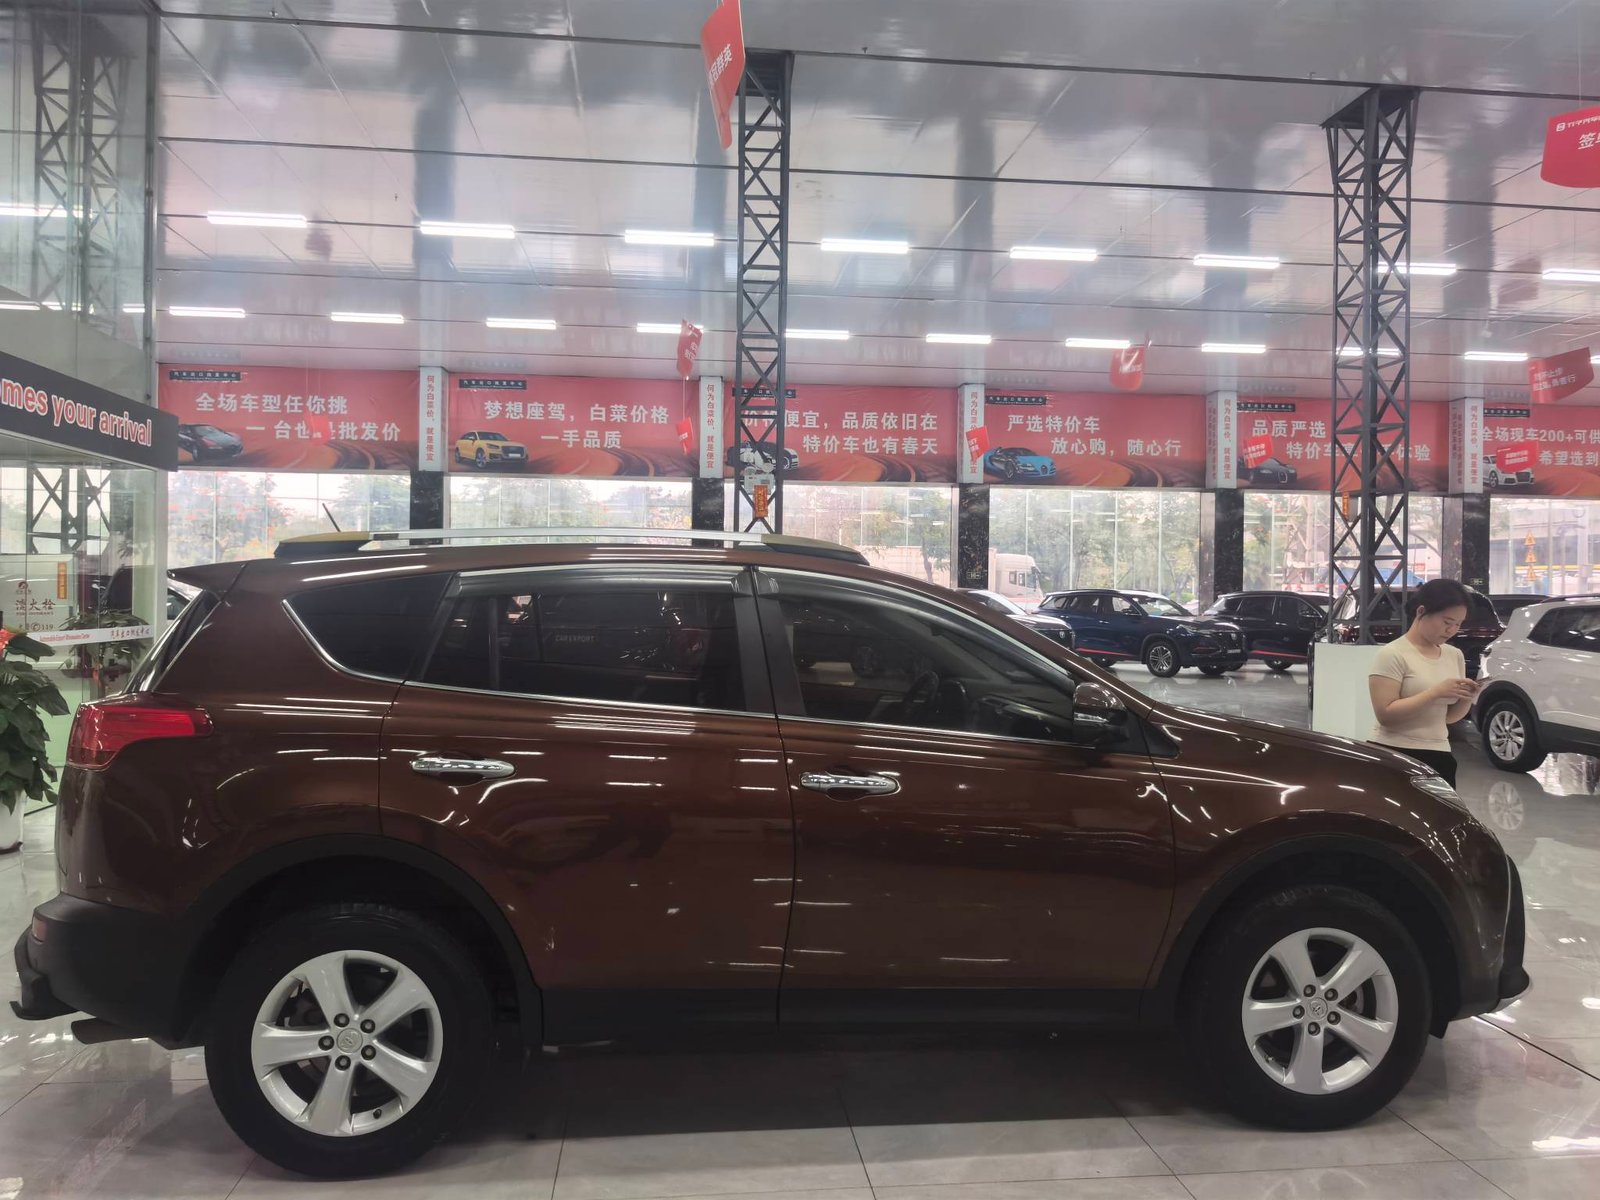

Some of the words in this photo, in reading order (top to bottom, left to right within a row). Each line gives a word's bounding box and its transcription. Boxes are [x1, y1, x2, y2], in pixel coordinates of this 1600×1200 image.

[0, 378, 48, 416] mes
[52, 395, 97, 430] your
[99, 411, 152, 447] arrival
[195, 391, 349, 416] 全场车型任你挑
[484, 400, 670, 425] 梦想座驾，白菜价格
[1007, 414, 1100, 433] 严选特价车
[1252, 419, 1327, 438] 品质严选
[540, 430, 622, 450] 一手品质
[803, 435, 938, 455] 特价车也有春天
[1051, 438, 1182, 457] 放心购，随心行
[1539, 450, 1598, 467] 希望选到
